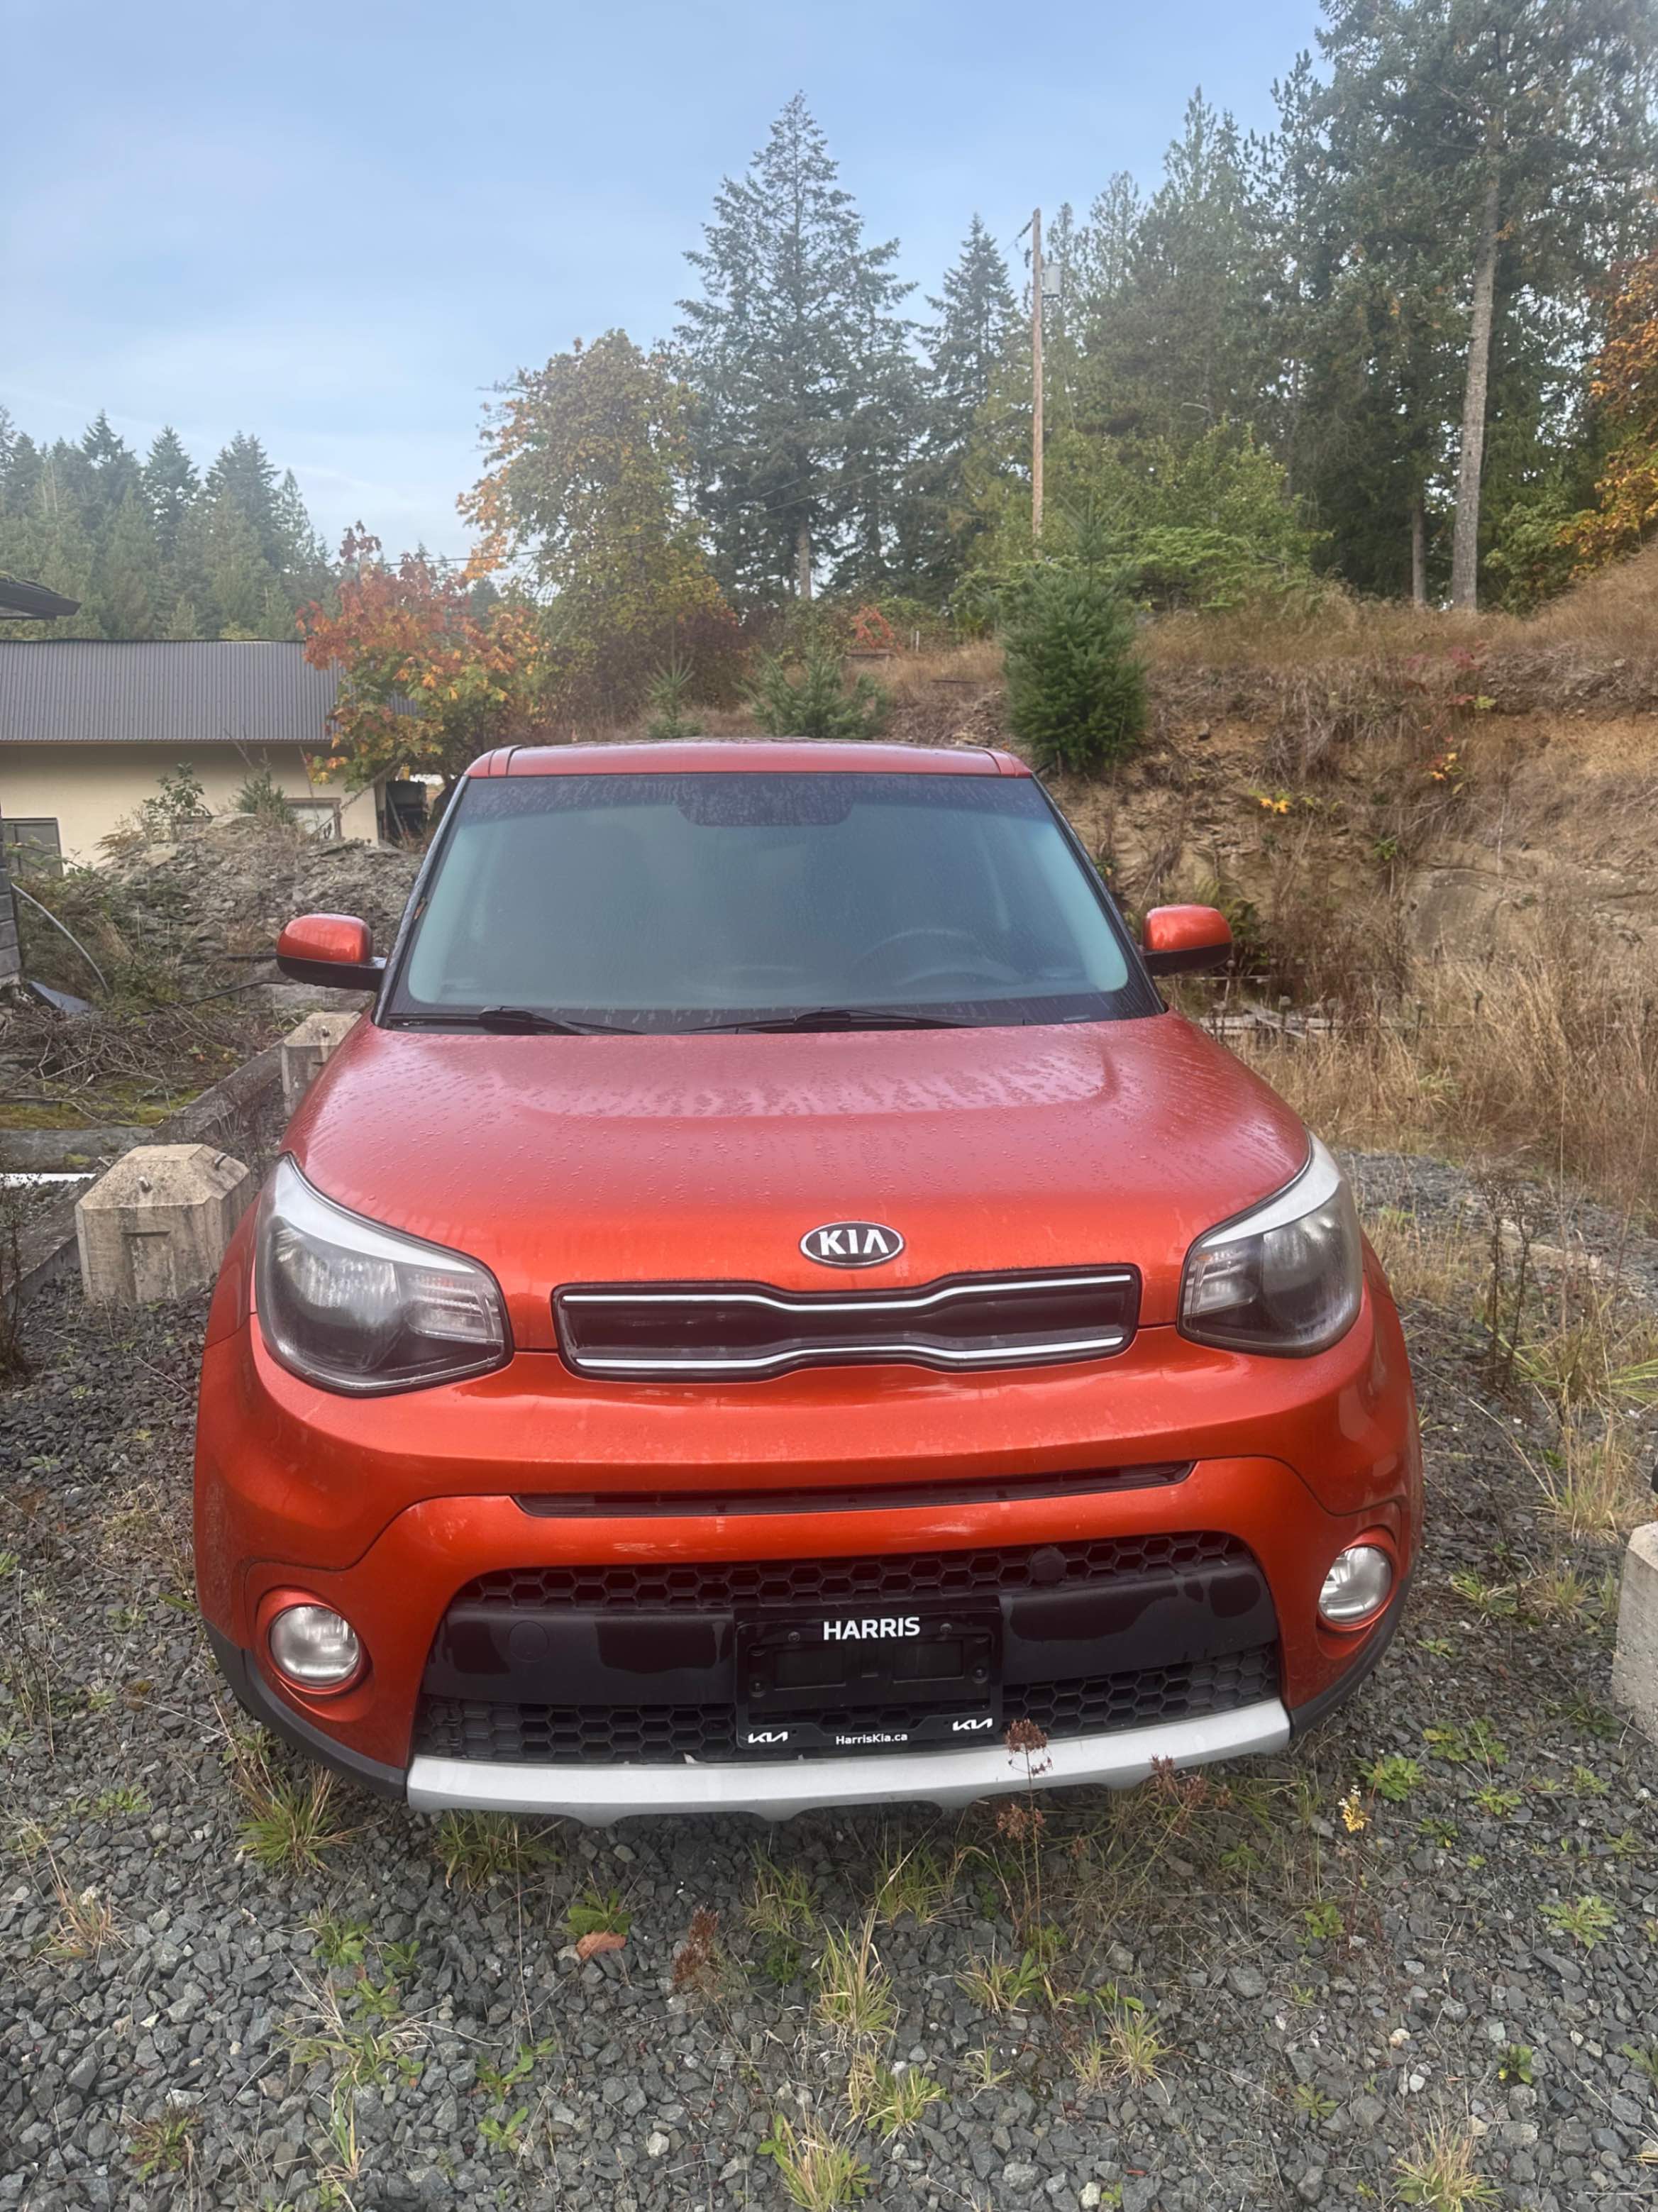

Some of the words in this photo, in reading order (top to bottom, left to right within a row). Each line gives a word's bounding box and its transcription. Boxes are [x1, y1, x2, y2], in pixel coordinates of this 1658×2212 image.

[818, 1229, 890, 1256] KIA
[823, 1617, 921, 1640] HARRIS
[835, 1733, 908, 1746] HarrisKia.ca
